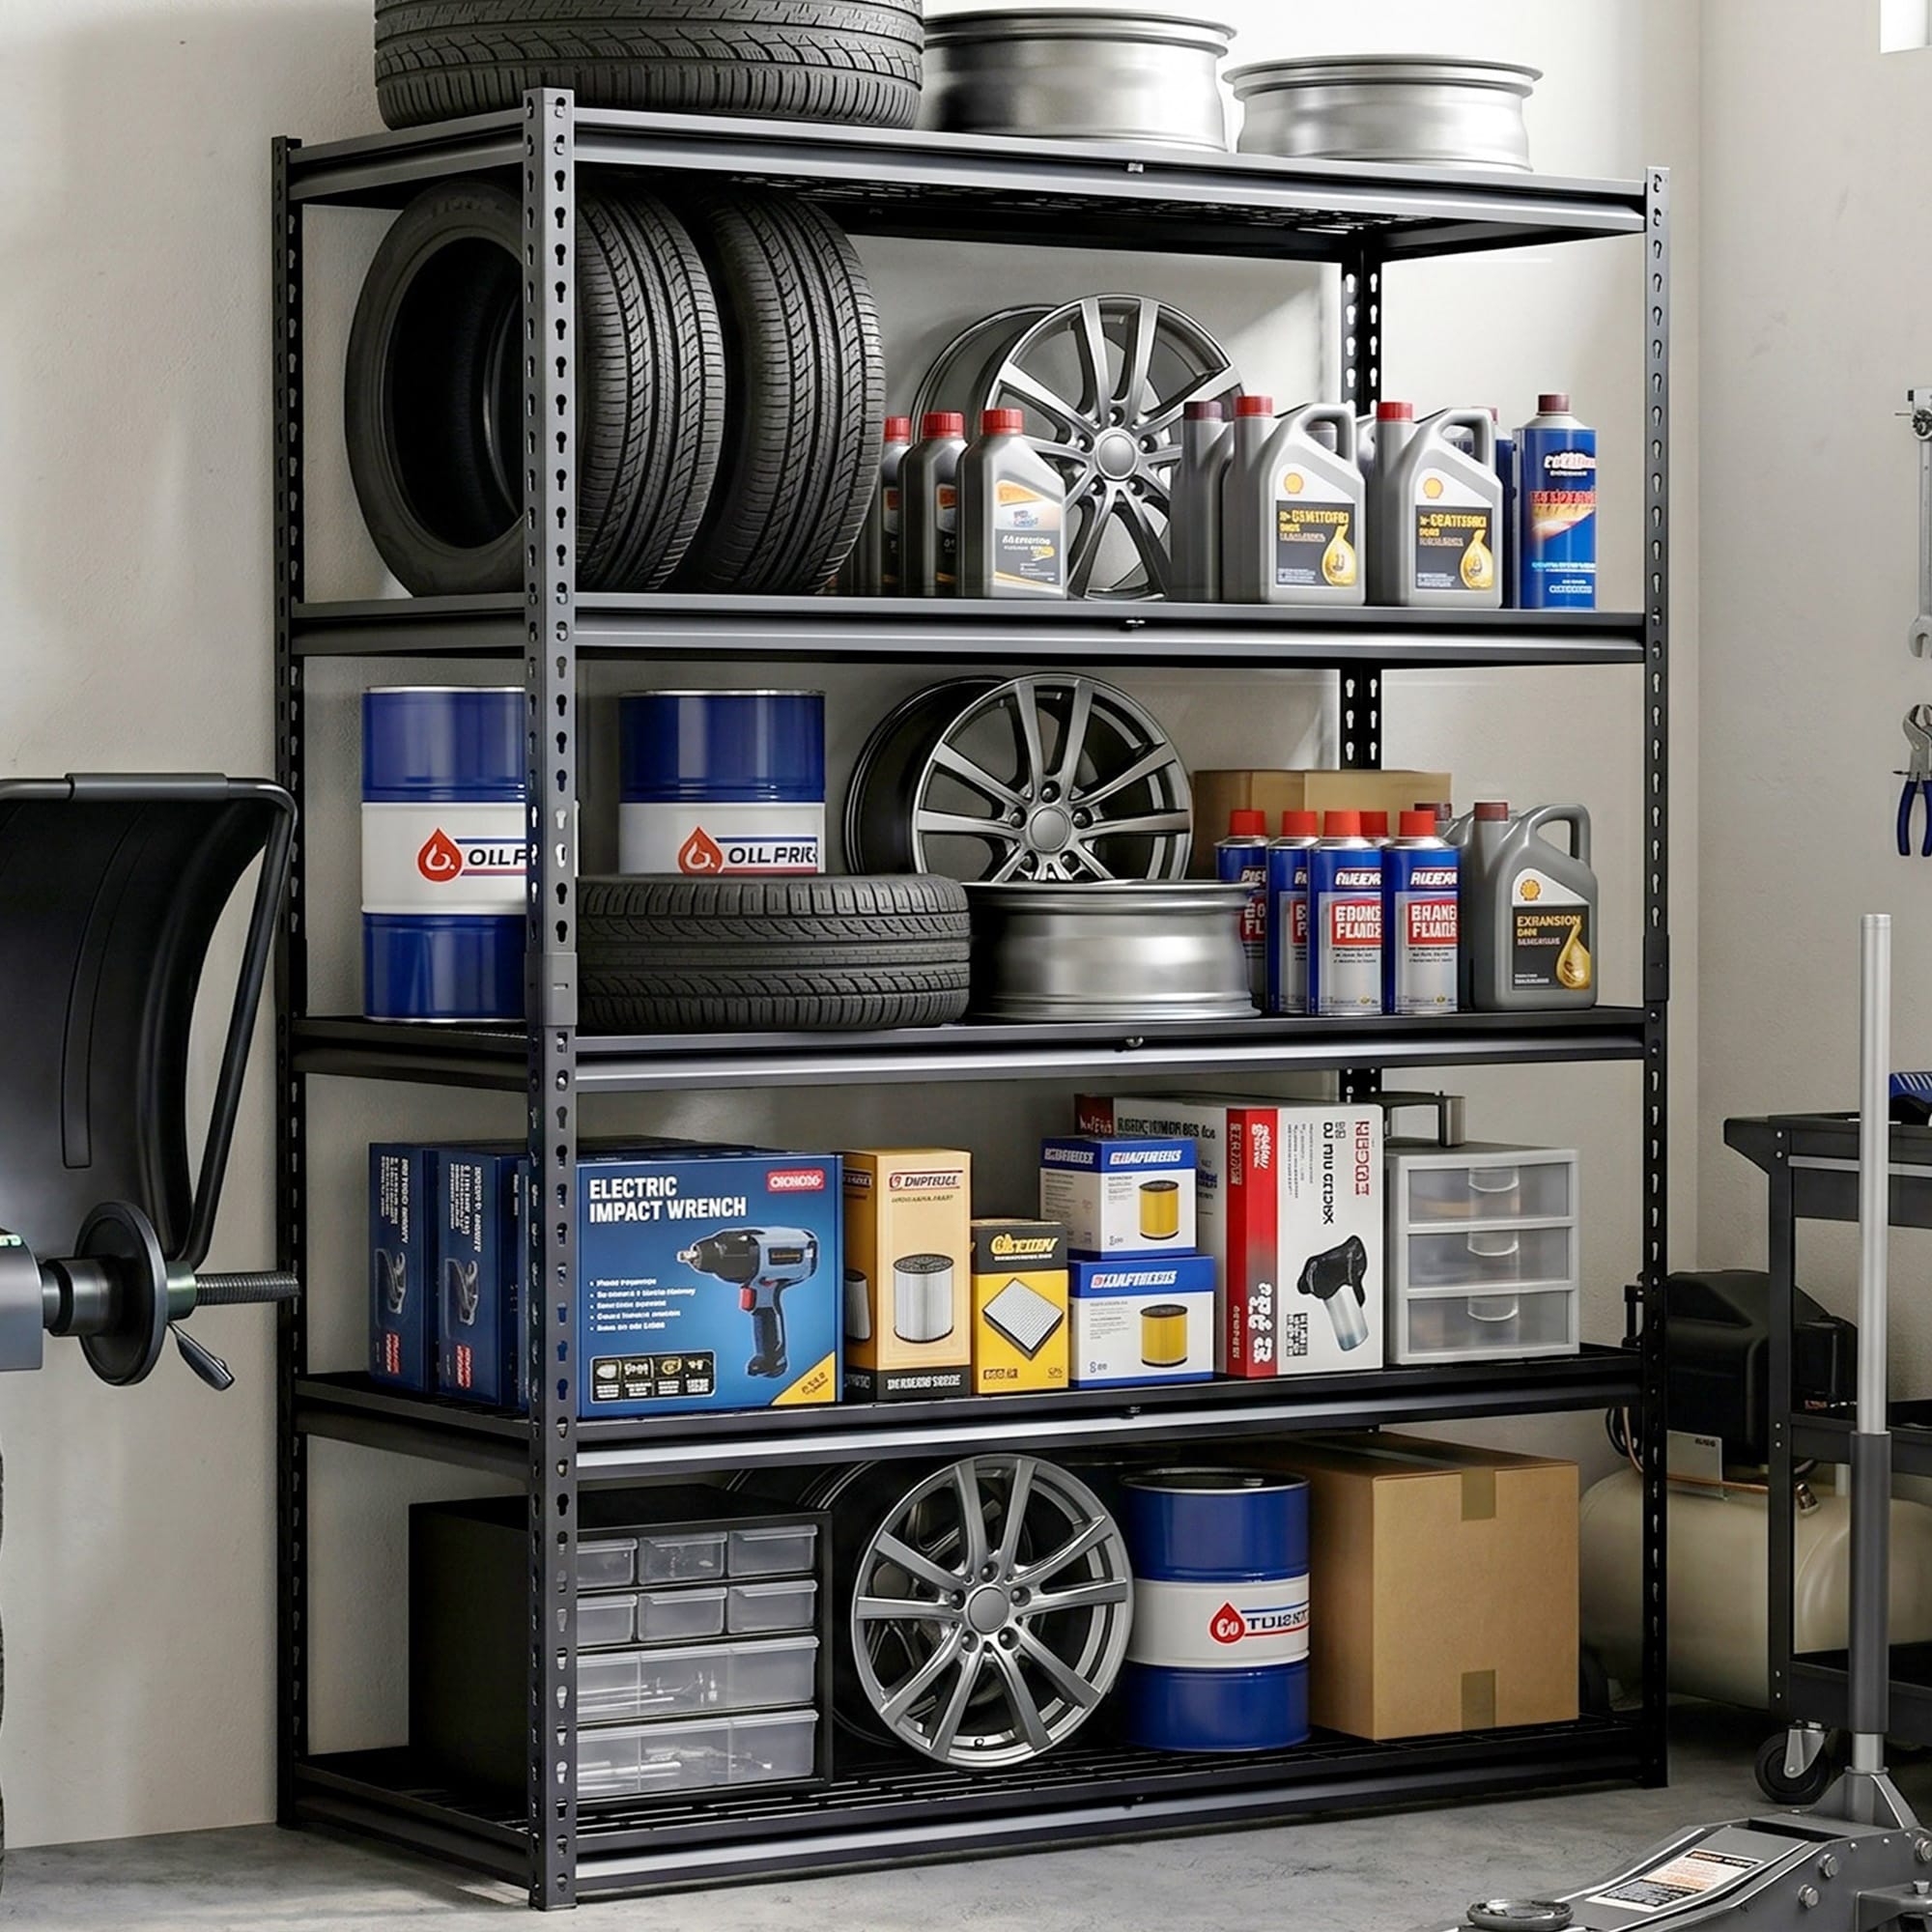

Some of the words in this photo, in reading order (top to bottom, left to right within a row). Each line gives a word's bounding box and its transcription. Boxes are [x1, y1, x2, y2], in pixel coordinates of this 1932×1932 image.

[589, 1176, 677, 1200] ELECTRIC
[589, 1200, 663, 1223] IMPACT
[667, 1197, 747, 1219] WRENCH
